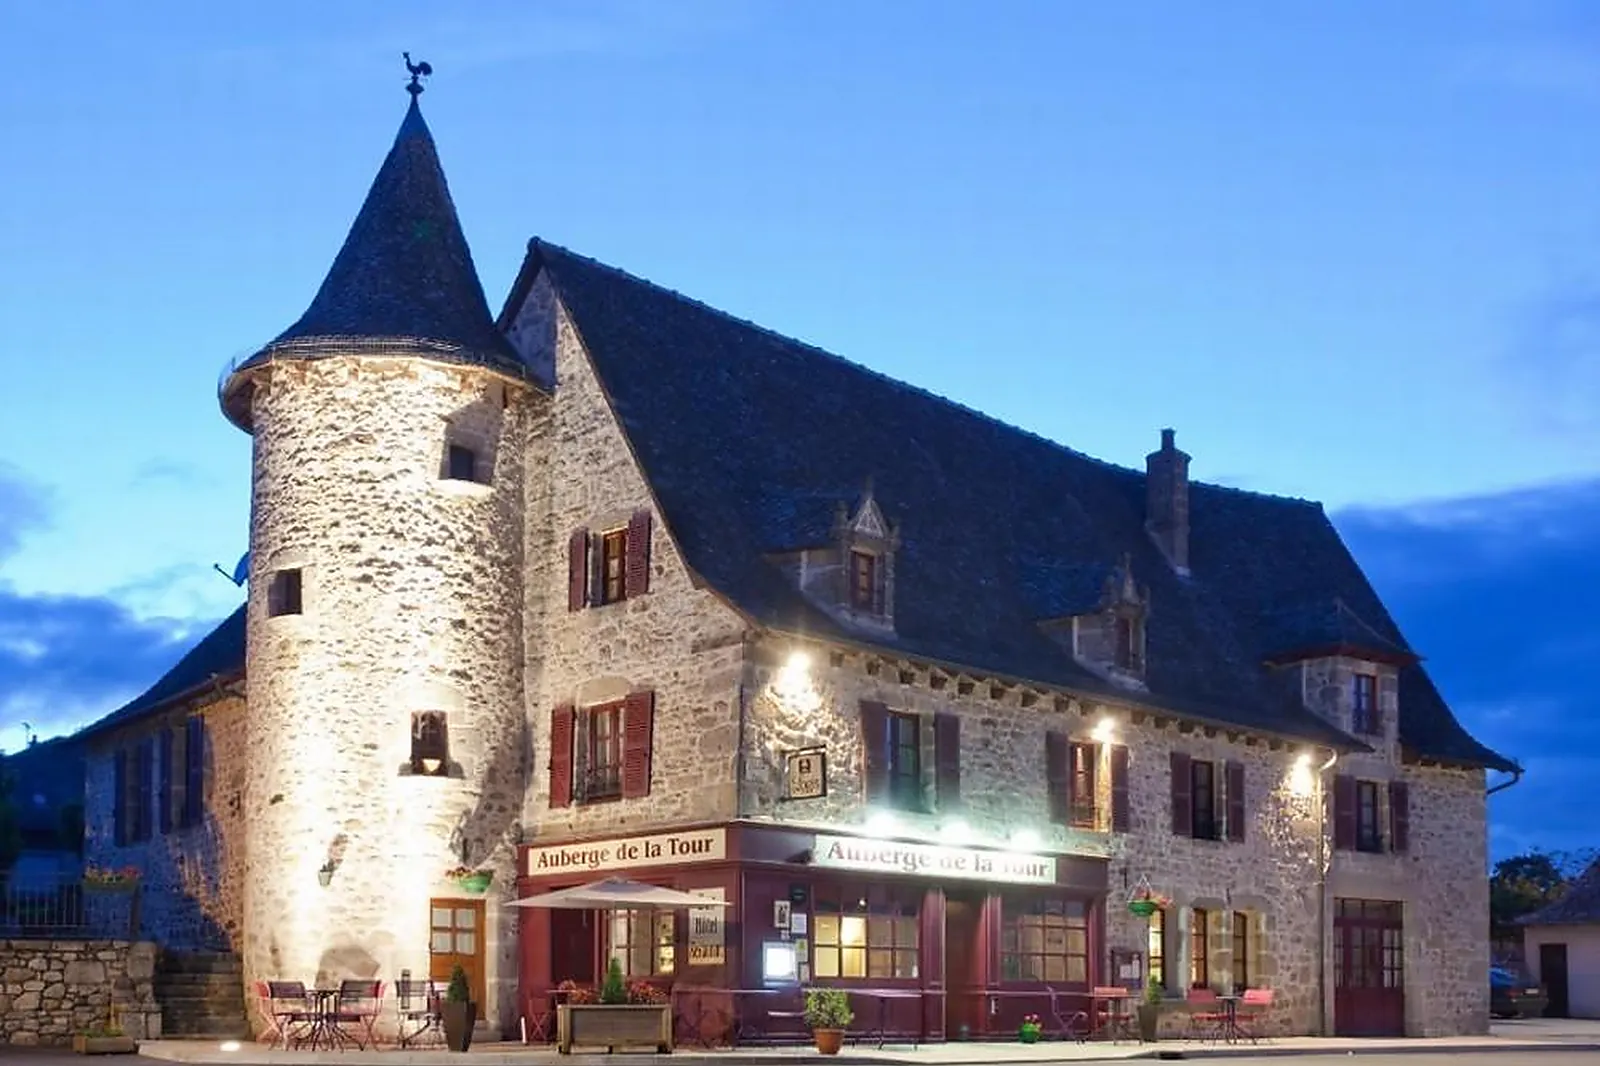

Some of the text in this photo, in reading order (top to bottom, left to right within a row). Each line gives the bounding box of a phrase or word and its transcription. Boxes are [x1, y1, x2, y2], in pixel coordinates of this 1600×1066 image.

[537, 837, 714, 869] Auberge de la Tour
[827, 840, 930, 872] Auberge
[974, 853, 993, 873] la
